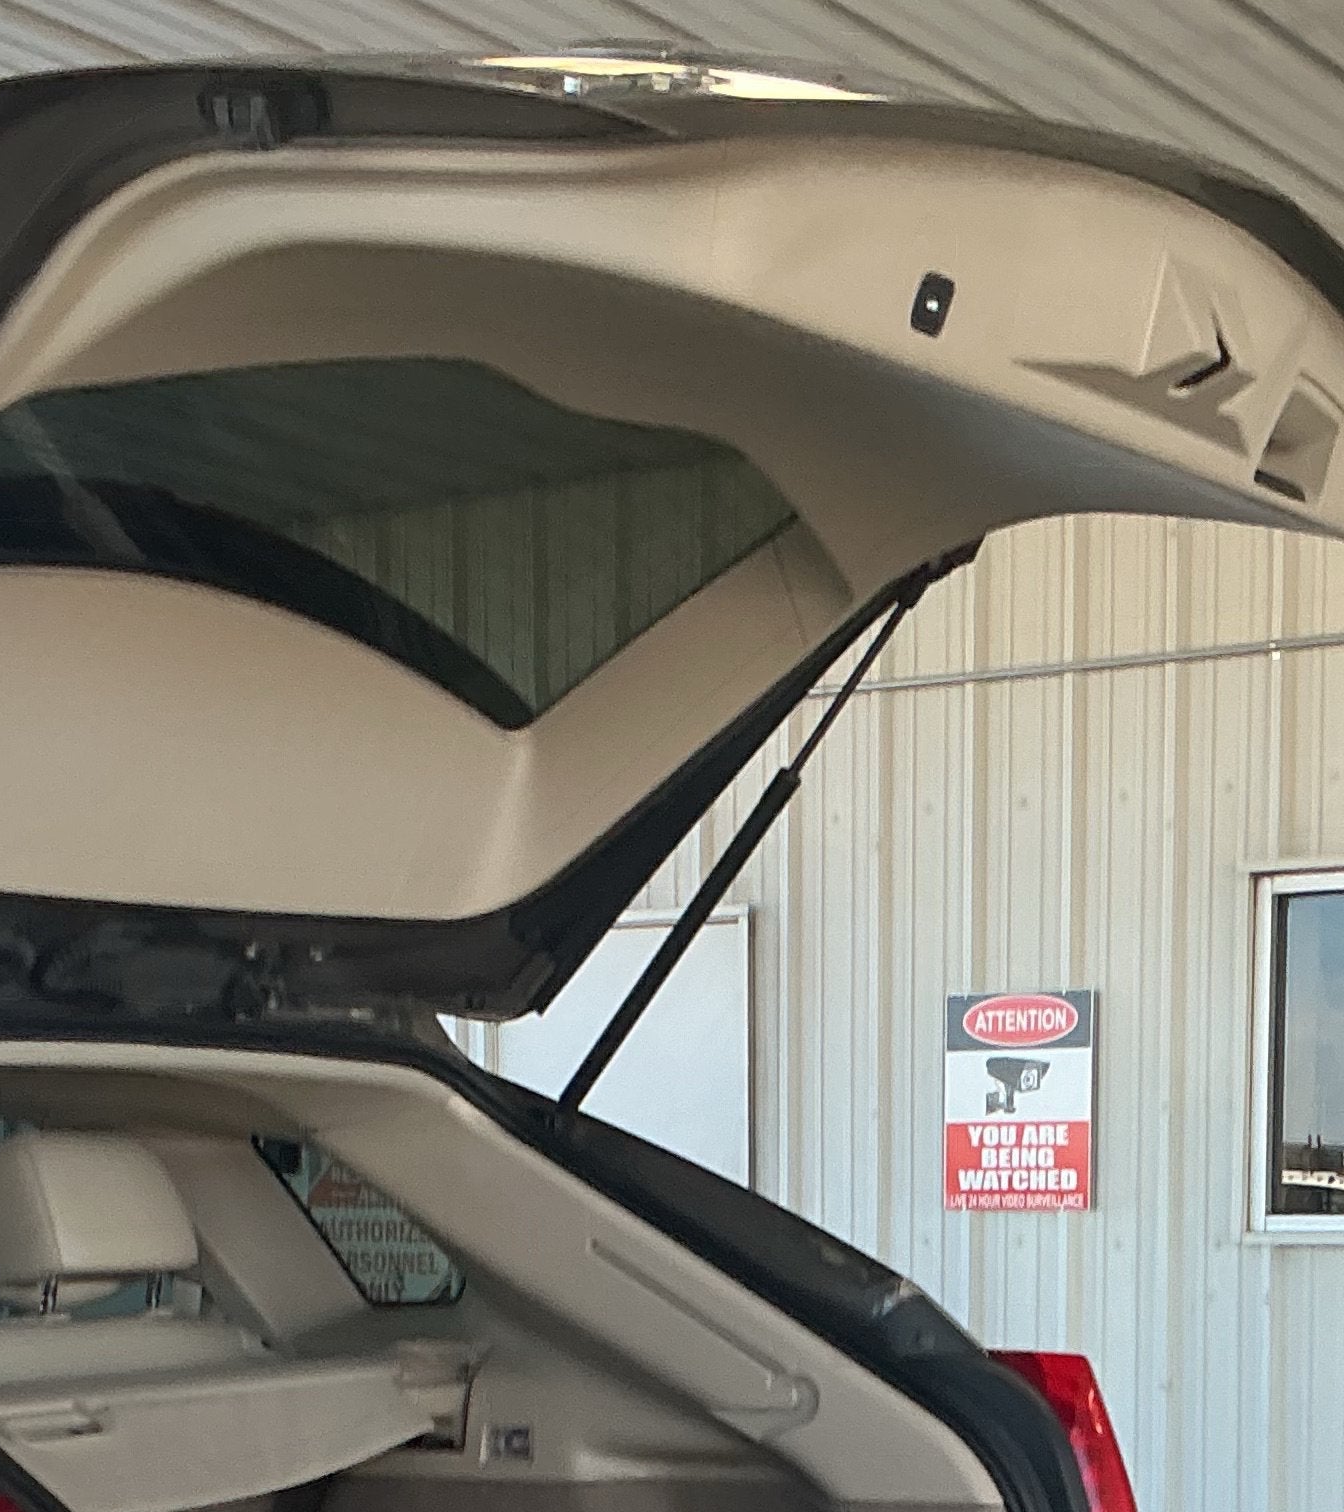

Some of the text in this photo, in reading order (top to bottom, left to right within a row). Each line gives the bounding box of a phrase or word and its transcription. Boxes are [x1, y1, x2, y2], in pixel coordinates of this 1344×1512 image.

[974, 1008, 1068, 1033] ATTENTION
[967, 1124, 1069, 1147] YOU ARE
[981, 1147, 1055, 1169] BEING
[958, 1168, 1078, 1191] WATCHED
[1001, 1193, 1025, 1208] VIDEO
